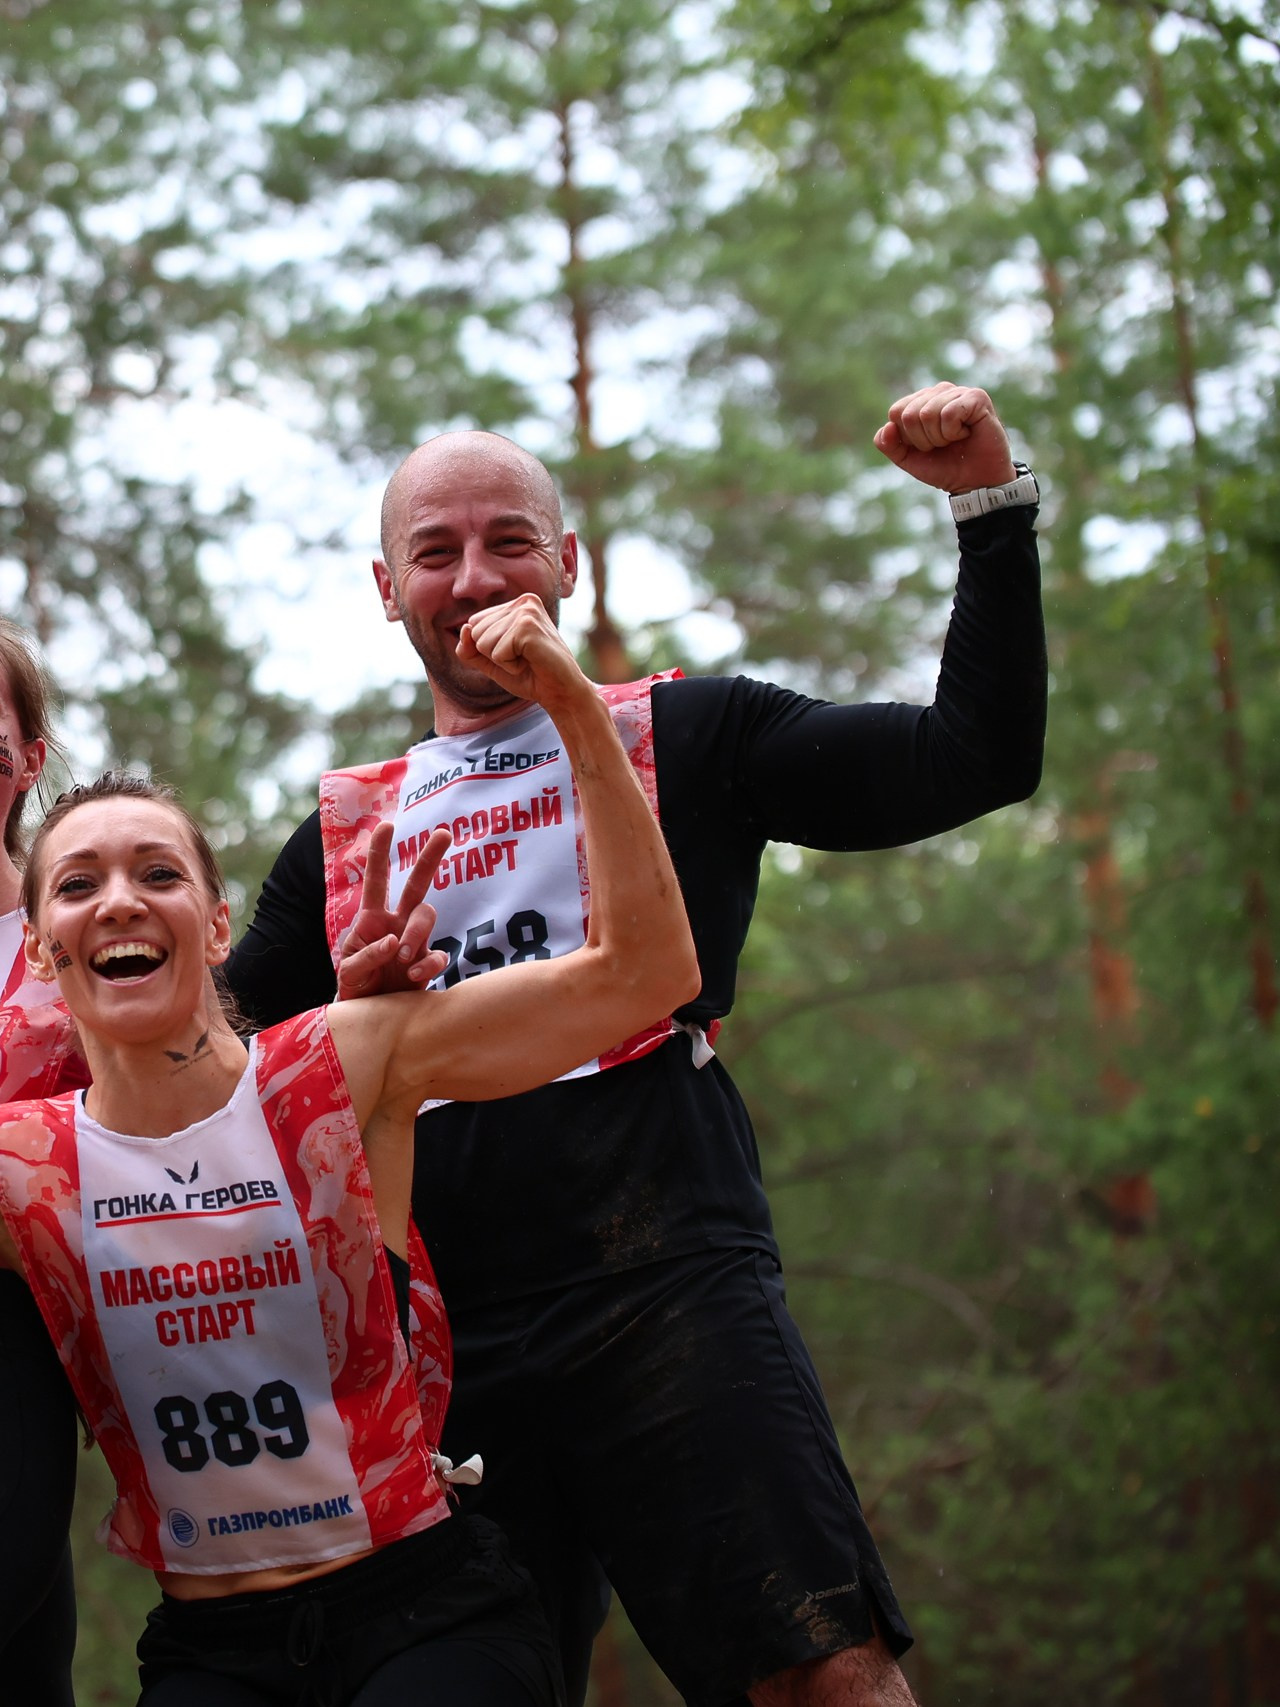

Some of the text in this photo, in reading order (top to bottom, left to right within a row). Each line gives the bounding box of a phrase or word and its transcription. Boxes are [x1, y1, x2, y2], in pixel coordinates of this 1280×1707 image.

[405, 765, 463, 808] ГОНКА
[397, 786, 563, 873] МАСОВЫЙ
[433, 839, 519, 892] СТАРТ
[93, 1180, 279, 1220] ГОНКА ГЕРОЕВ
[99, 1238, 302, 1308] МАССОВЫЙ
[155, 1298, 256, 1347] СТАРТ
[153, 1379, 310, 1473] 889
[207, 1494, 355, 1537] ГАЗПРОМБАНК
[815, 1582, 858, 1600] DEMIX
